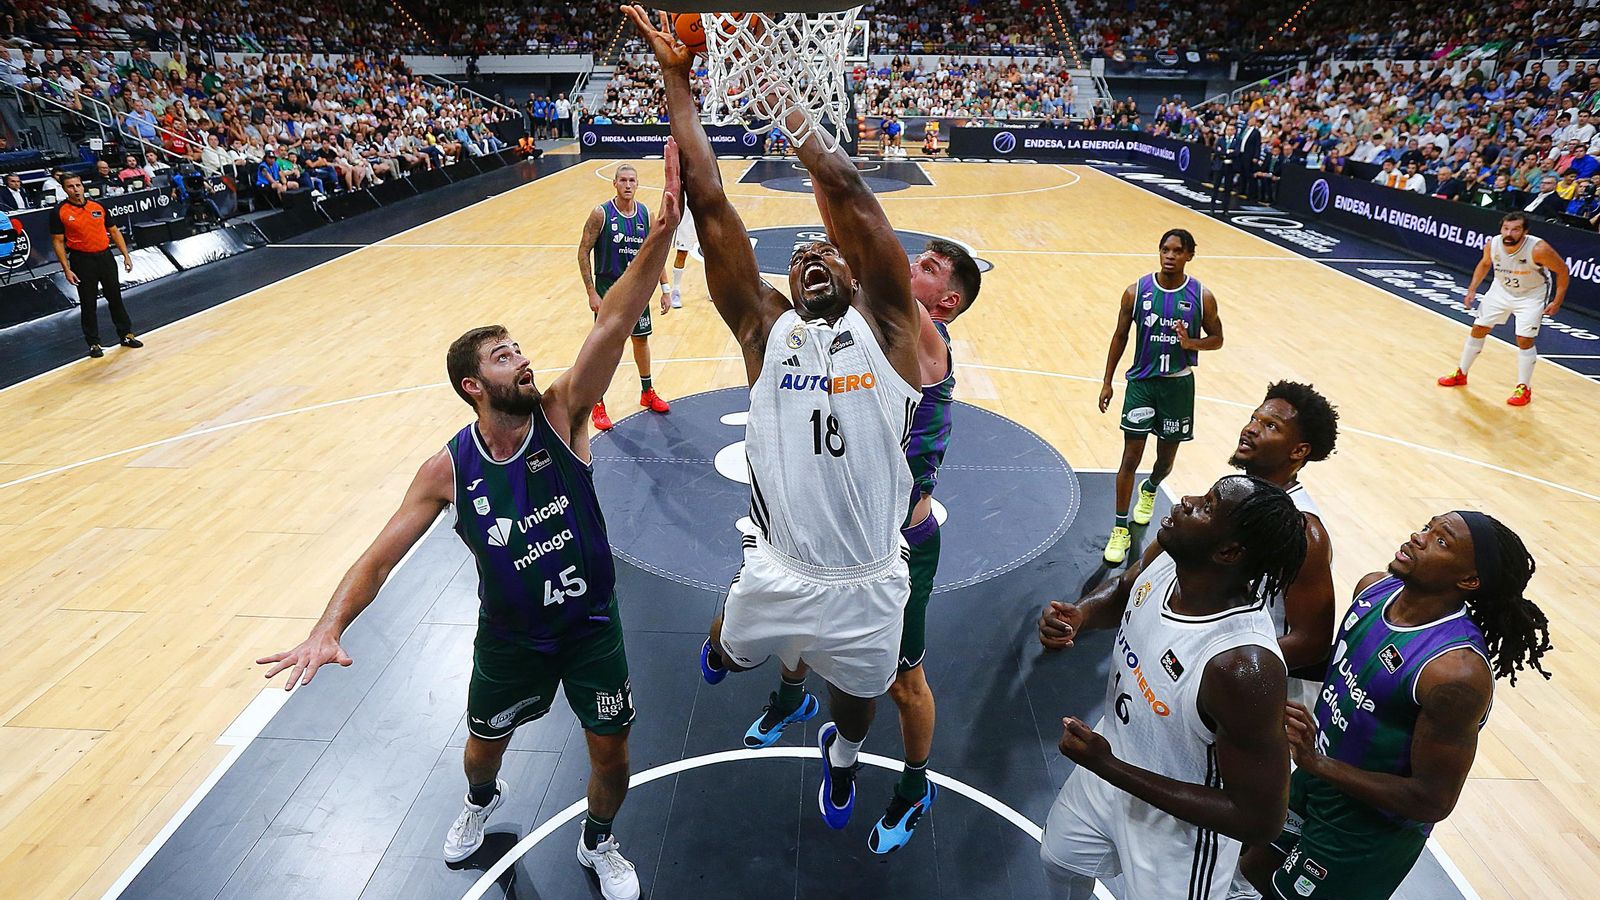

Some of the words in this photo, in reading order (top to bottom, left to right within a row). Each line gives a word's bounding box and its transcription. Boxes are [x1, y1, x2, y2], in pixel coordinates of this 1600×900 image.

[713, 134, 737, 142] MÚSICA
[1024, 139, 1066, 150] ENDESA,
[1067, 140, 1081, 149] LA
[1082, 139, 1125, 151] ENERGÍA
[1334, 195, 1373, 219] ENDESA,
[1374, 205, 1387, 222] LA
[1388, 210, 1437, 236] ENERGÍA
[1439, 223, 1463, 244] DEL
[1504, 277, 1520, 288] 23
[1159, 354, 1170, 373] 11
[808, 409, 846, 458] 18
[517, 495, 570, 534] Unicaja
[543, 565, 588, 606] 45
[1339, 657, 1376, 713] Unicaja
[1305, 864, 1320, 876] acb
